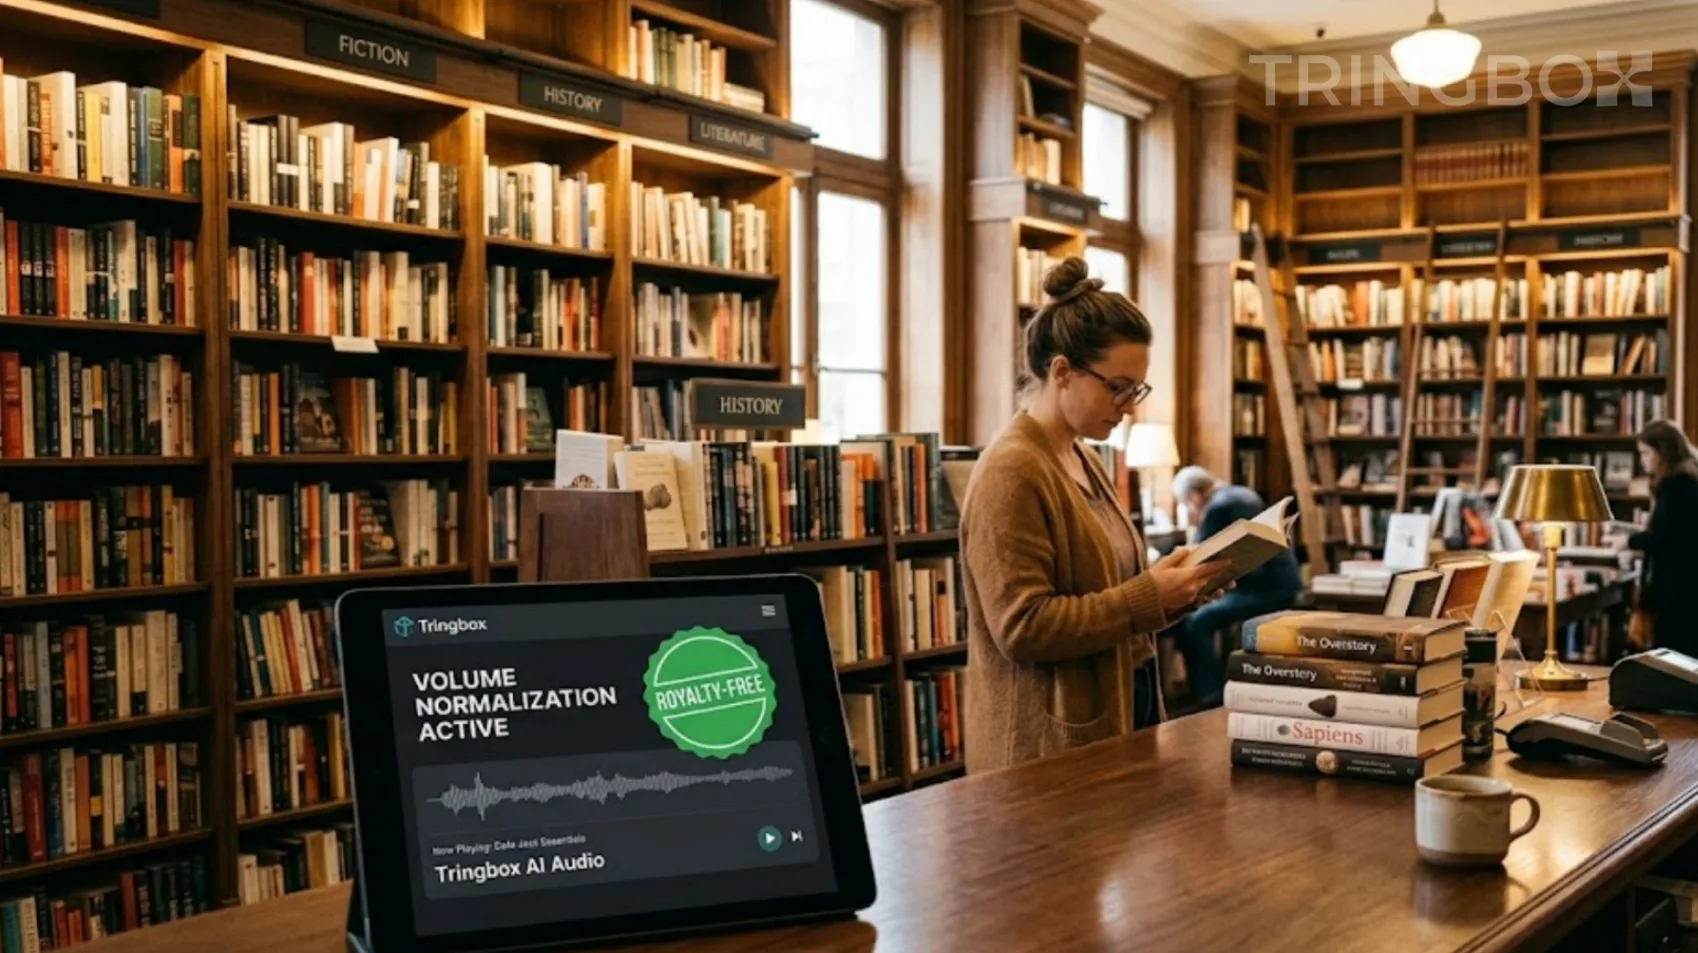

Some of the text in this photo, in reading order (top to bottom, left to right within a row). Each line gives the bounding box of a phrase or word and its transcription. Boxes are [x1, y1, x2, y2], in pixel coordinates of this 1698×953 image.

[339, 34, 409, 68] FICTION
[543, 85, 602, 113] HISTORY
[720, 396, 783, 415] HISTORY
[418, 617, 487, 635] Tringbox
[1296, 635, 1377, 654] The Overstory
[412, 668, 518, 691] VOLUME
[1242, 663, 1262, 677] The
[415, 686, 618, 716] NORMALIZATION
[655, 673, 766, 711] ROYALTY-FREE
[418, 717, 510, 742] ACTIVE
[1292, 721, 1364, 746] Sapiens
[434, 852, 606, 884] Tringbox AI Audio
